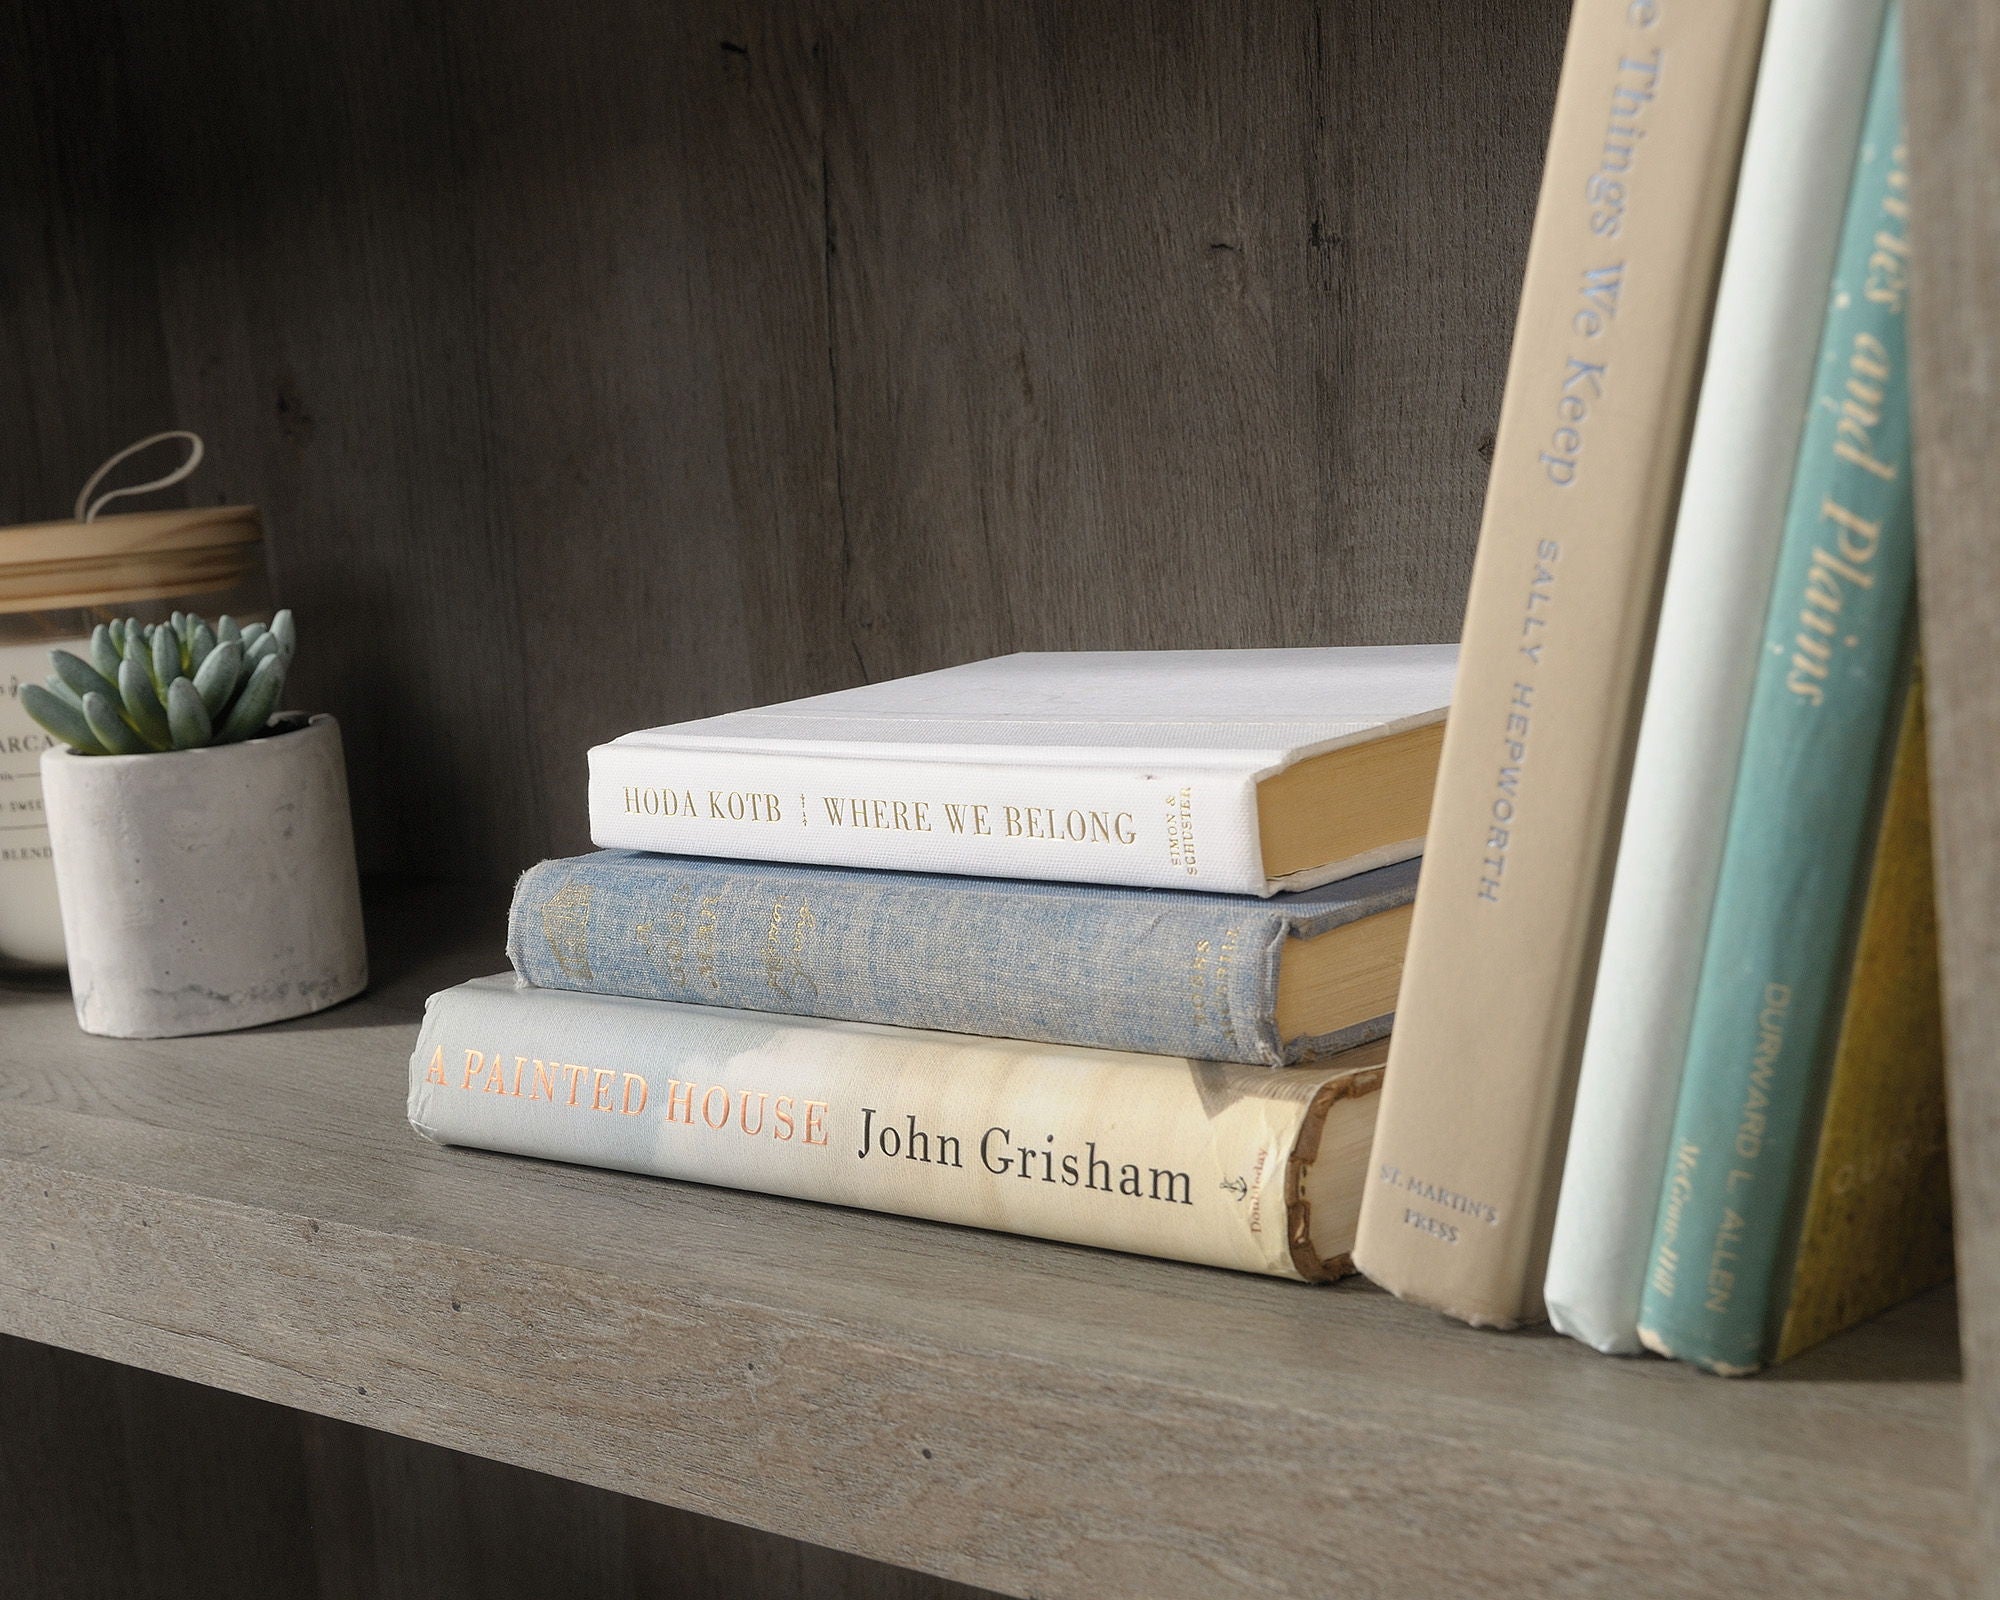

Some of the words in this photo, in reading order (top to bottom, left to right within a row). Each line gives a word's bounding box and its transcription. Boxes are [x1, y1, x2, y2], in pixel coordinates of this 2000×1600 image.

[1585, 47, 1664, 239] Things
[1572, 262, 1626, 339] We
[1540, 356, 1607, 489] Keep
[1833, 330, 1897, 482] and
[1519, 538, 1560, 665] SALLY
[1785, 495, 1882, 708] Plains
[623, 786, 697, 818] HODA
[709, 788, 783, 823] KOTB
[822, 795, 932, 834] WHERE
[945, 800, 992, 837] WE
[1004, 804, 1137, 845] BELONG
[1165, 795, 1176, 807] &
[1166, 813, 1181, 866] SIMON
[1180, 786, 1198, 876] SCHUSTER
[1477, 682, 1534, 904] HEPWORTH
[426, 1044, 449, 1088] A
[460, 1048, 648, 1117] PAINTED
[666, 1078, 831, 1148] HOUSE
[856, 1107, 964, 1169] John
[980, 1127, 1194, 1207] Grisham
[1735, 981, 1792, 1160] DURWARD
[1404, 1208, 1462, 1244] PRESS
[1407, 1177, 1499, 1225] MARTIN'S
[1704, 1207, 1747, 1314] ALLEN
